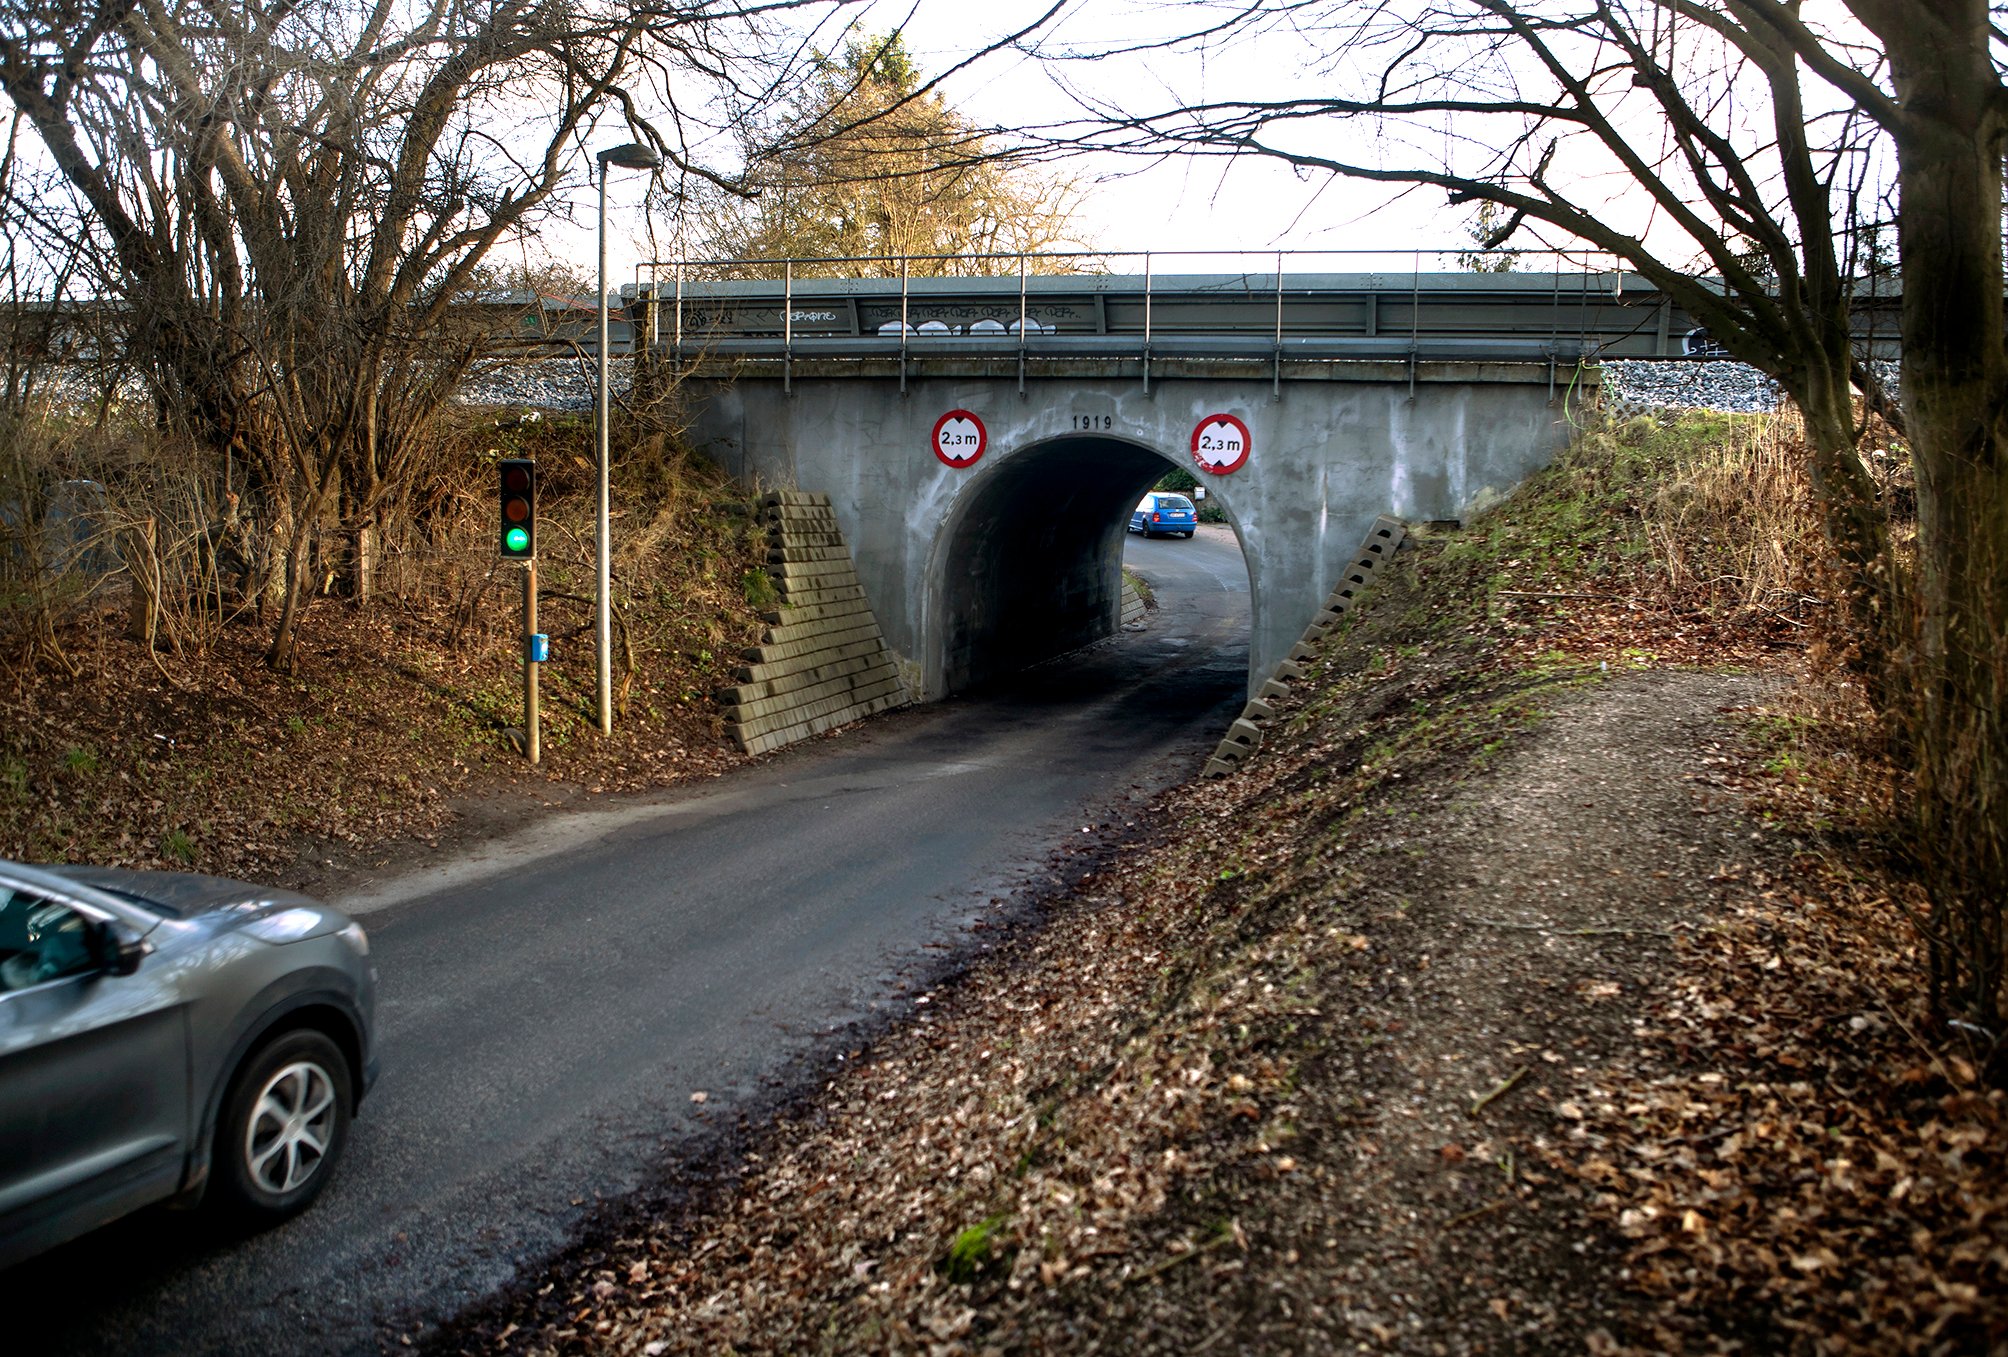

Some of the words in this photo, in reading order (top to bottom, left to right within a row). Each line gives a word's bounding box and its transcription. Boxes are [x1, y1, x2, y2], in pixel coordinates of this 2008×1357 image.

[1072, 415, 1112, 430] 1919
[941, 431, 962, 446] 2,3
[965, 435, 977, 445] m
[1201, 435, 1224, 451] 2,3
[1227, 440, 1240, 451] m
